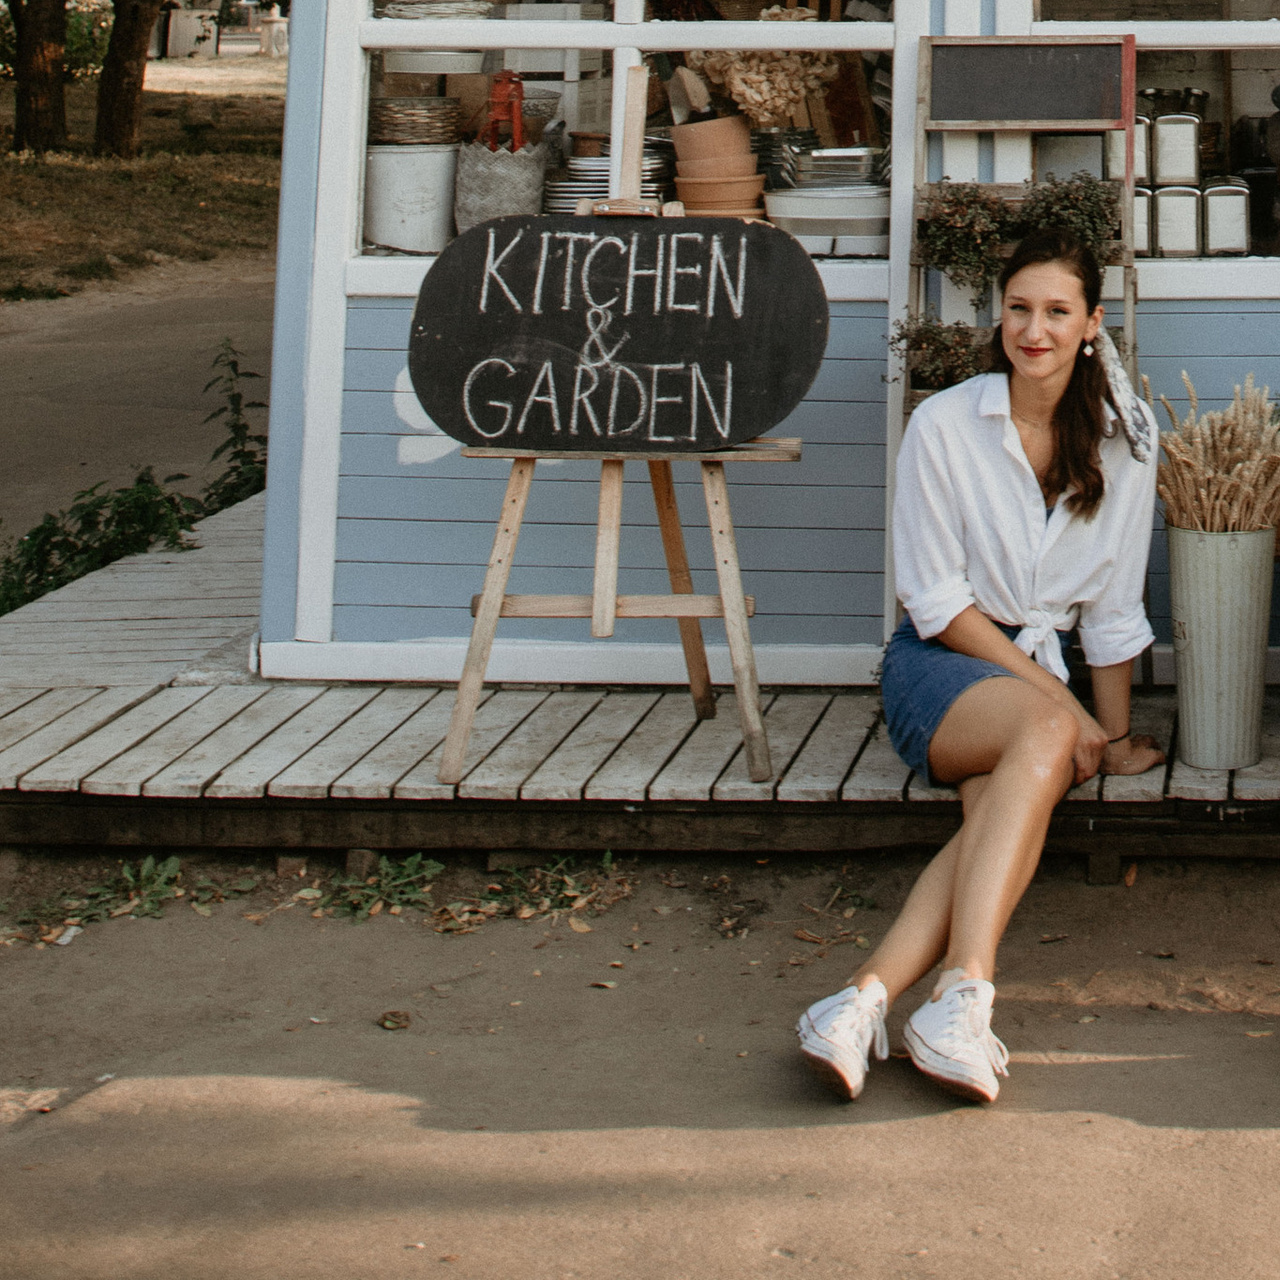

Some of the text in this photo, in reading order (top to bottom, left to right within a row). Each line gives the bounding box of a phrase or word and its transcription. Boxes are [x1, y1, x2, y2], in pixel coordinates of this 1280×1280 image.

[479, 227, 747, 319] KITCHEN
[581, 307, 631, 368] &
[462, 357, 733, 441] GARDEN
